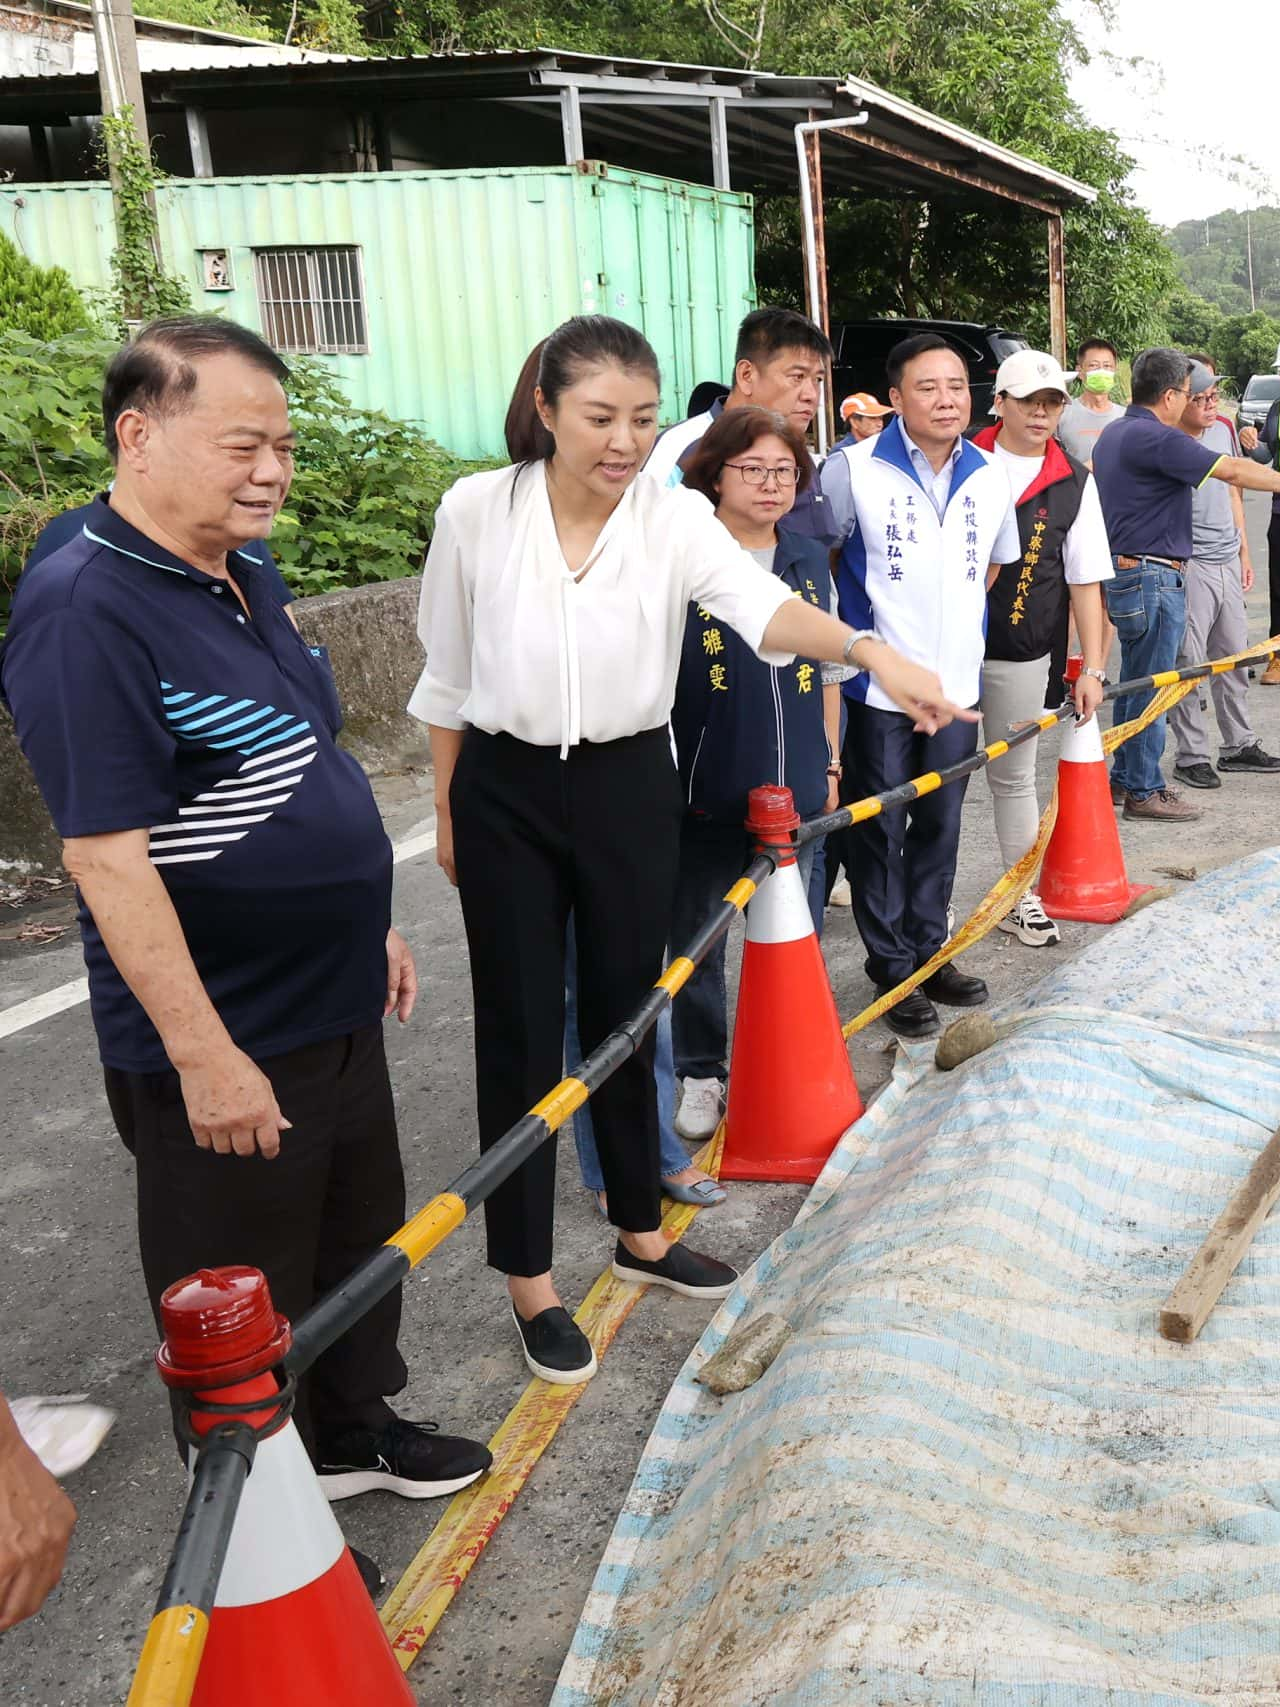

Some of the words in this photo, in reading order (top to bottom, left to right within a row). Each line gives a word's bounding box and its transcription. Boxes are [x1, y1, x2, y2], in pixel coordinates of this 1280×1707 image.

[885, 524, 904, 582] 張弘岳
[962, 495, 979, 582] 南投縣政府
